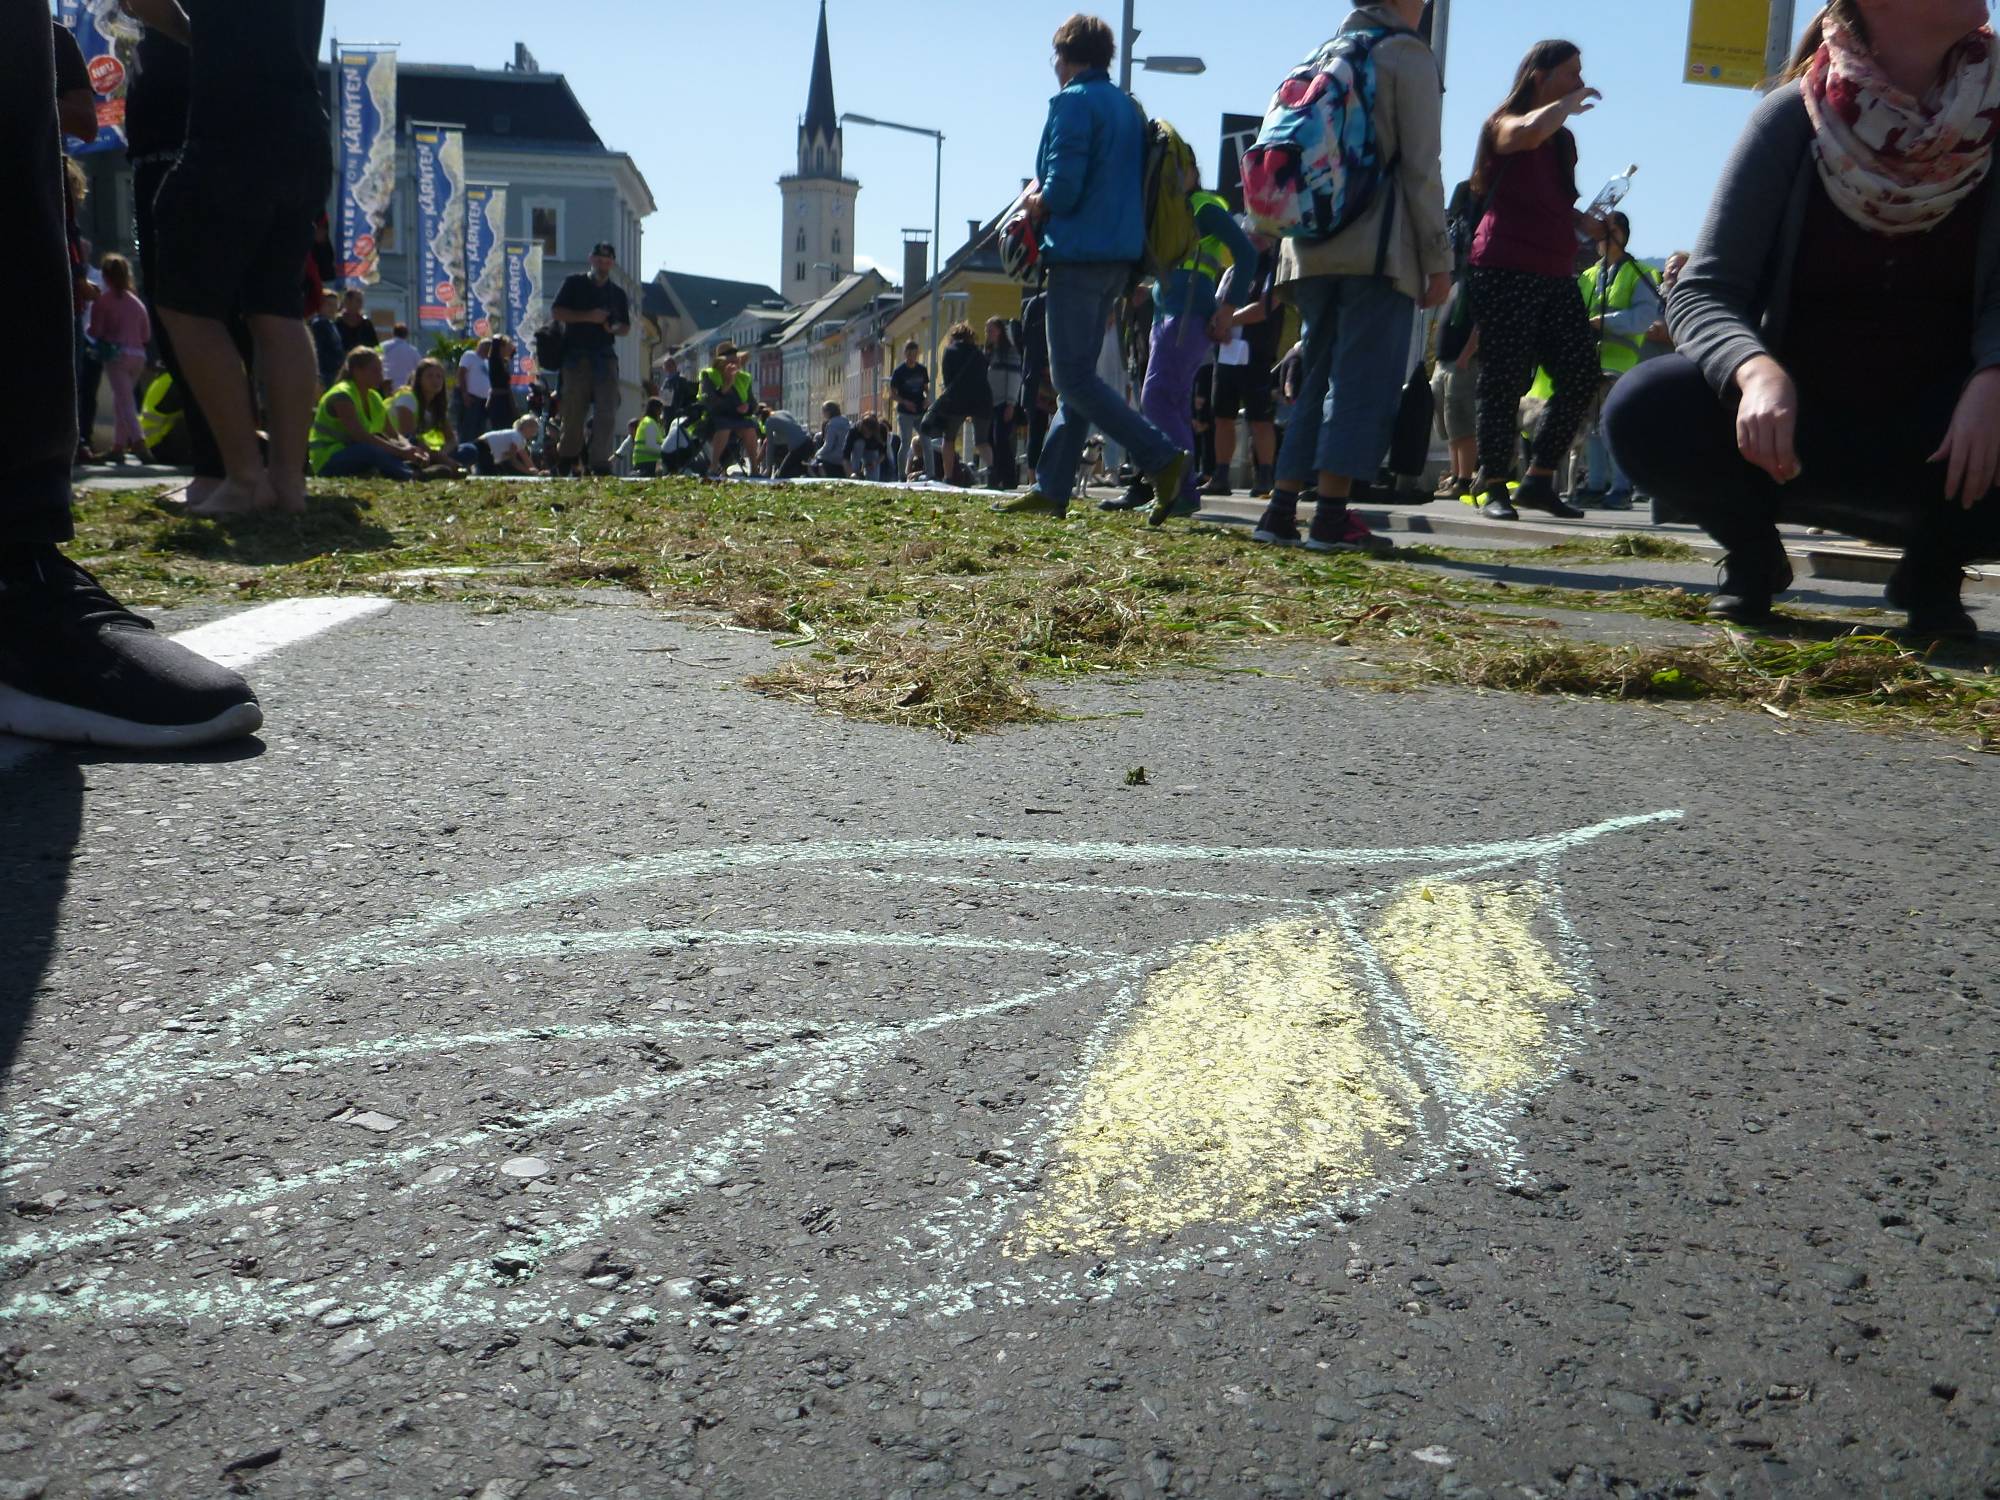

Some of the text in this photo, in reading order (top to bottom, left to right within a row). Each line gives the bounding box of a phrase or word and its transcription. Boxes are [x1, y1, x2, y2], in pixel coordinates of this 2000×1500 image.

[342, 67, 363, 154] KÄRNTEN
[417, 143, 438, 215] KÄRNTEN
[466, 200, 481, 262] KÄRNTEN
[425, 251, 434, 304] RELIEF
